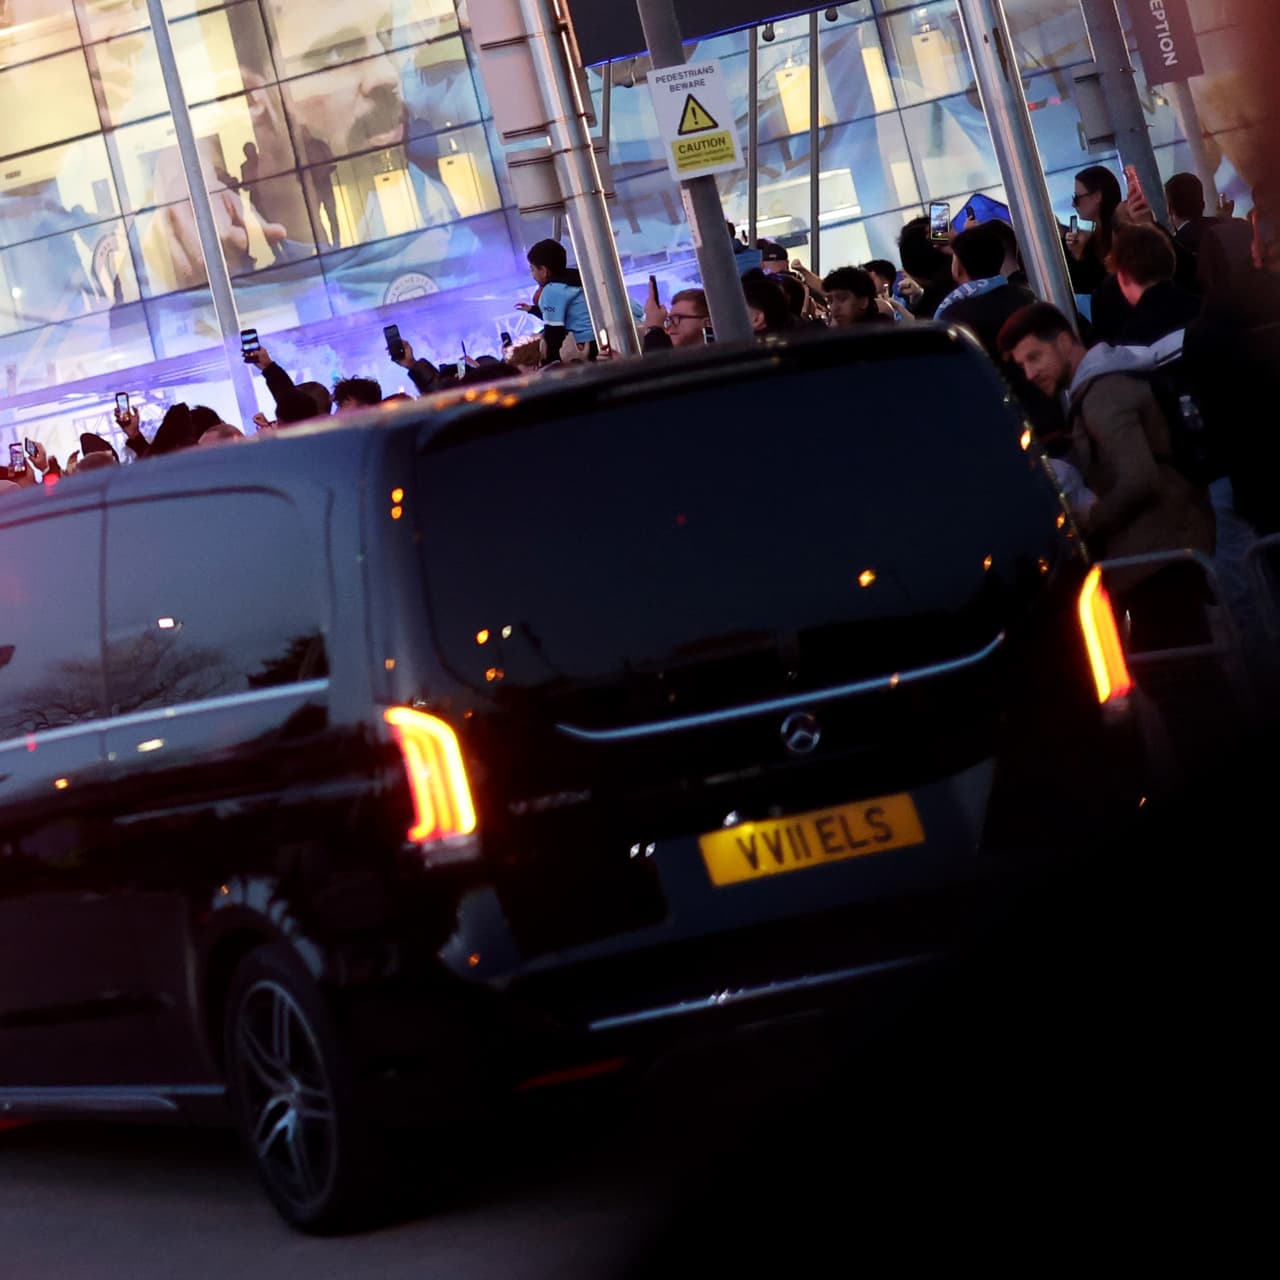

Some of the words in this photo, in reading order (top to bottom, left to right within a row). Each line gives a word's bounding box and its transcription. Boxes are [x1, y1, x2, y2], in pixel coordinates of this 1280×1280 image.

[655, 66, 715, 84] PEDESTRIANS
[669, 78, 706, 92] BEWARE
[678, 136, 726, 154] CAUTION
[816, 806, 893, 855] ELS
